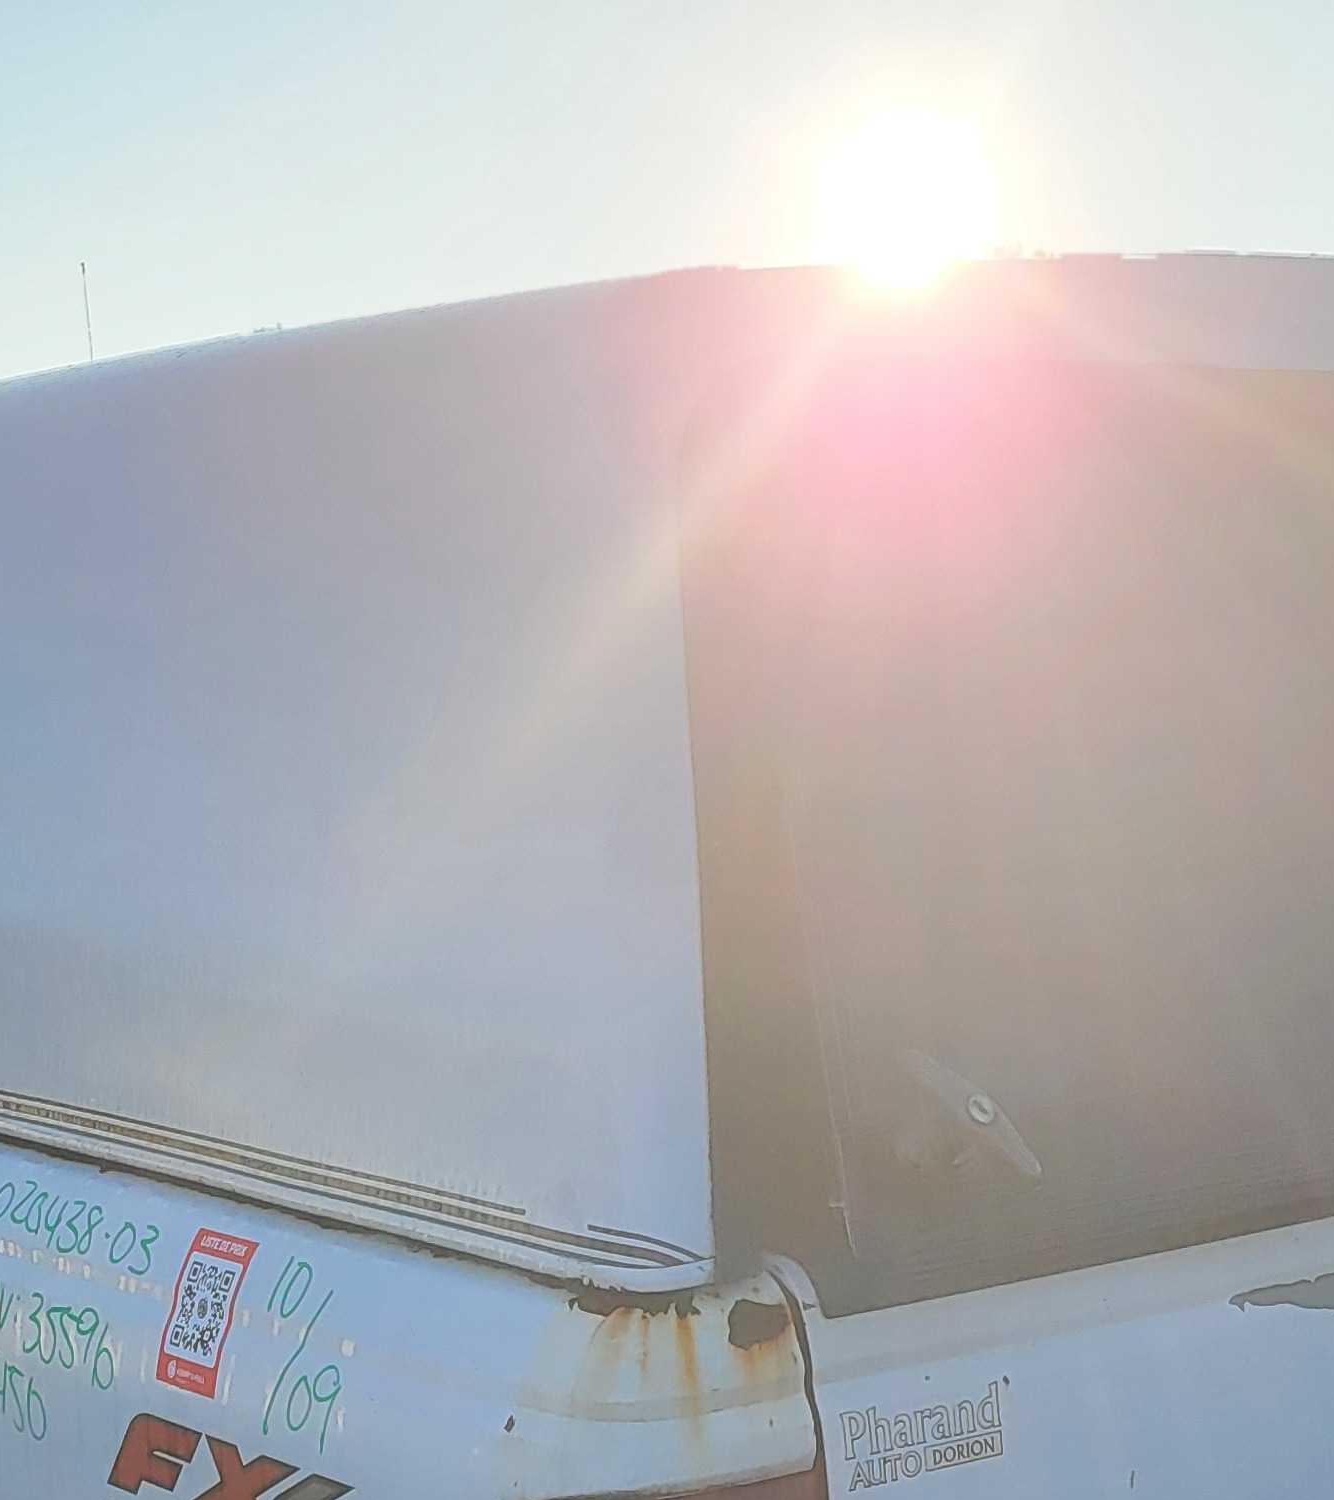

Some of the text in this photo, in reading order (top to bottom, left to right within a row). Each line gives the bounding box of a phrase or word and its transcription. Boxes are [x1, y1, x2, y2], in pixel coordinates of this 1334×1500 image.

[839, 1380, 1003, 1461] Pharand
[848, 1436, 996, 1492] AUTO DORION
